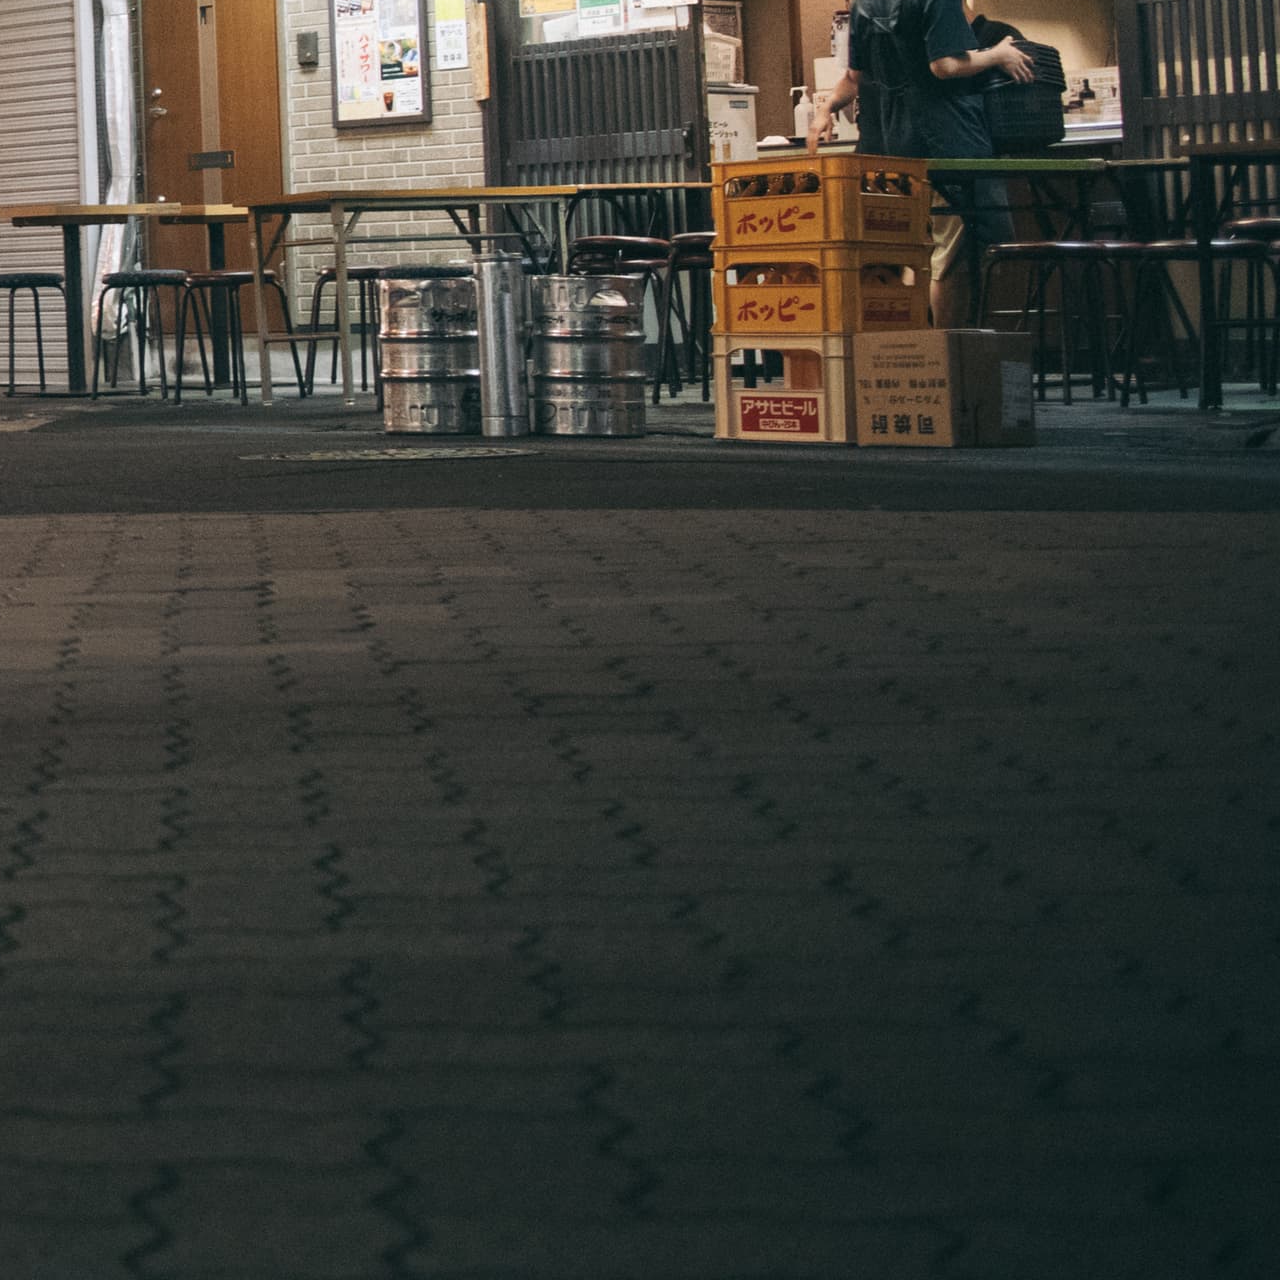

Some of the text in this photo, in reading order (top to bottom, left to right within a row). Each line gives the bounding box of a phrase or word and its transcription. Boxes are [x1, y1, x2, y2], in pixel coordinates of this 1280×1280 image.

[359, 33, 373, 83] ハイサワー
[737, 205, 816, 235] ホッピー
[737, 296, 816, 322] ホッピー
[742, 399, 816, 416] アサヒビール
